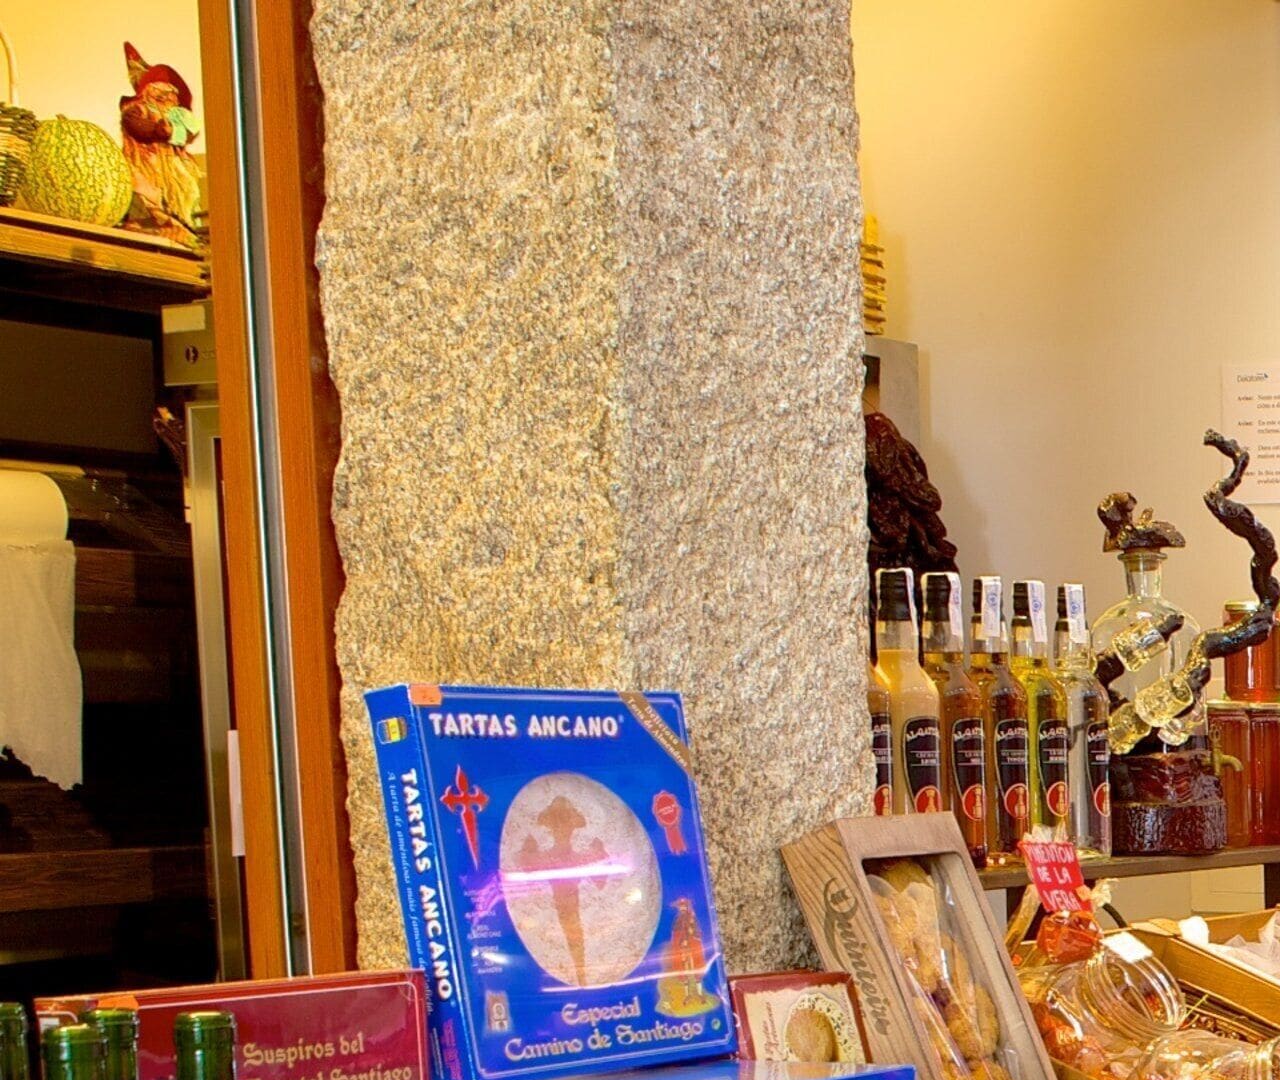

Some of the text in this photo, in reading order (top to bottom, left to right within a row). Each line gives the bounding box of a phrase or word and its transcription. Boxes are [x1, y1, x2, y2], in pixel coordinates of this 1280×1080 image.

[429, 713, 620, 739] TARTAS ANCANO
[401, 768, 432, 874] TARTAS
[419, 884, 454, 1002] ANCANO
[1053, 866, 1072, 885] LA
[560, 995, 642, 1027] Especial
[242, 1031, 365, 1069] Suspiros del
[504, 1019, 704, 1062] Camino de Santiago
